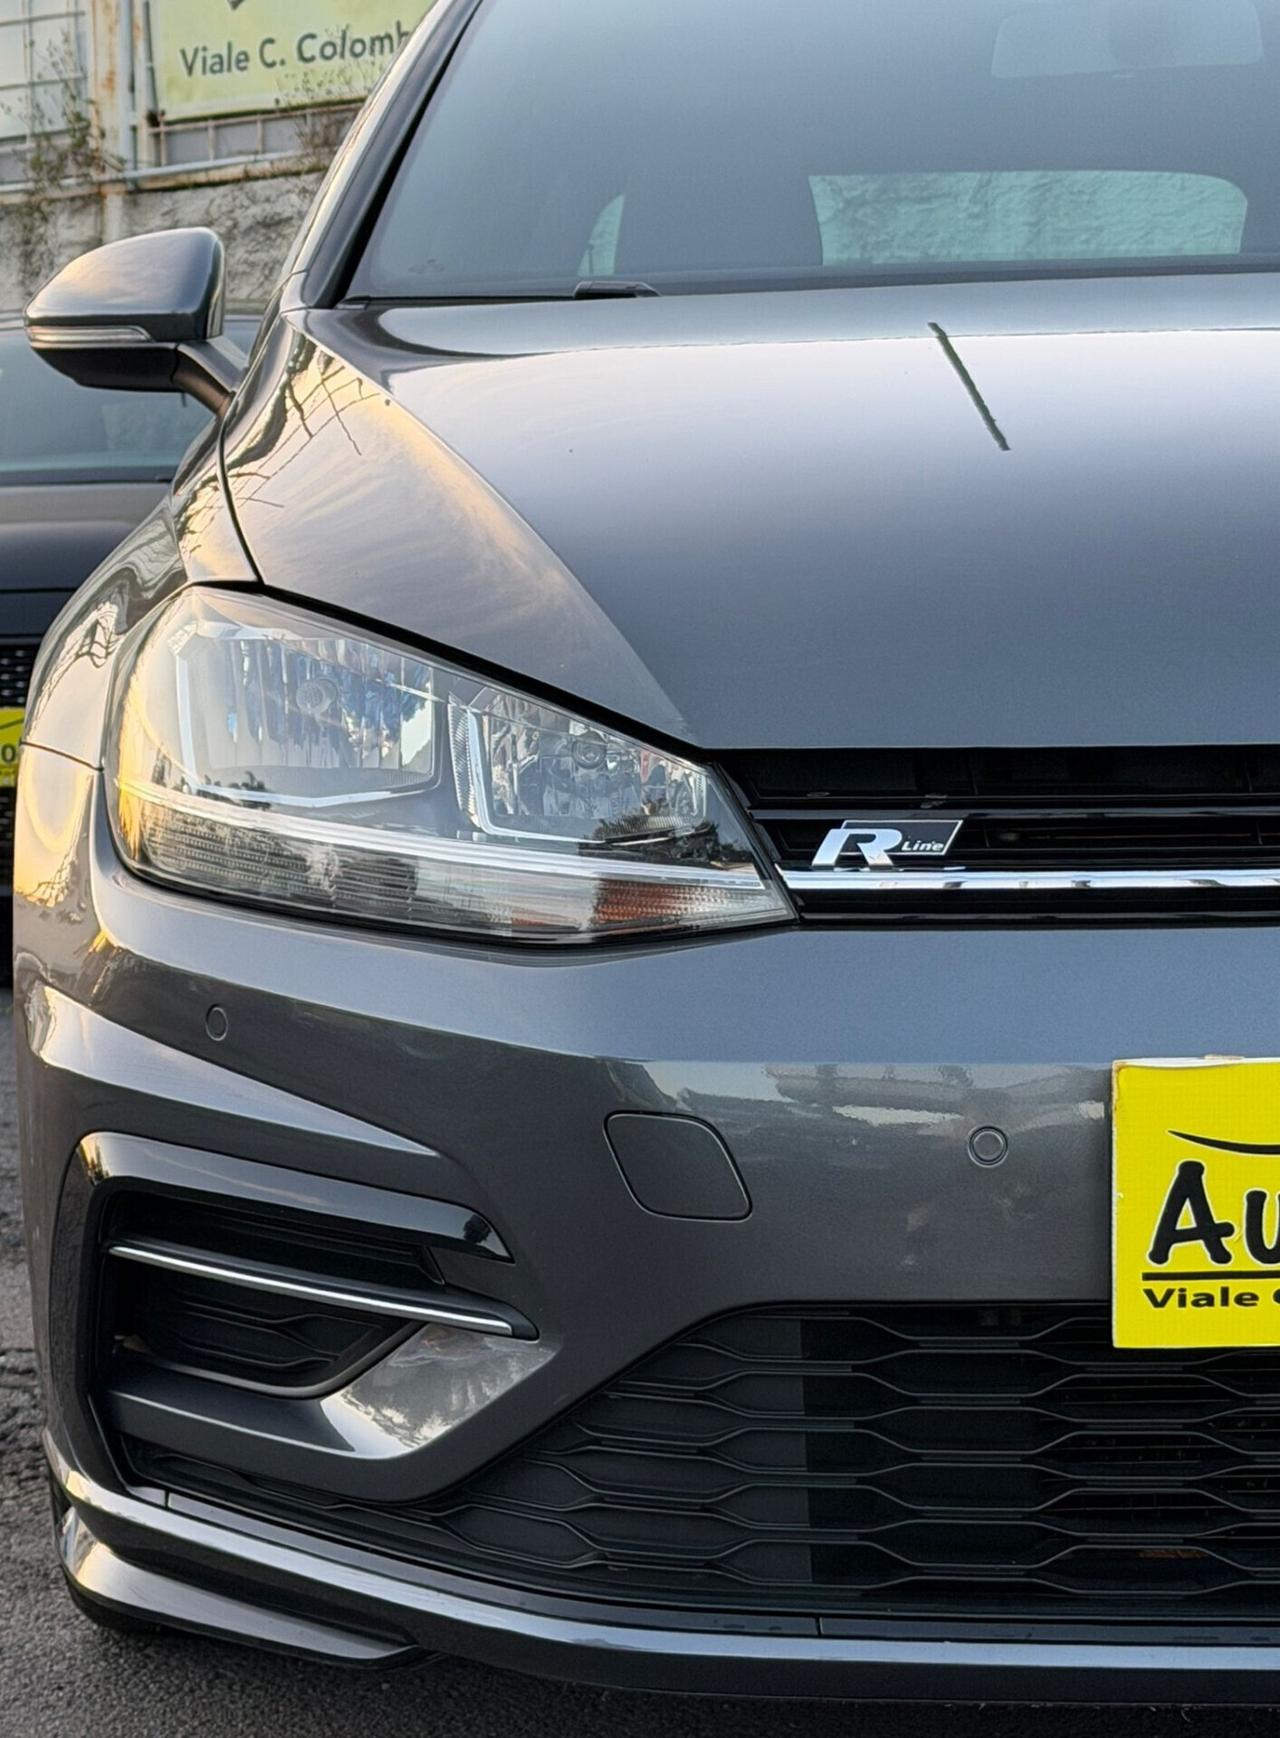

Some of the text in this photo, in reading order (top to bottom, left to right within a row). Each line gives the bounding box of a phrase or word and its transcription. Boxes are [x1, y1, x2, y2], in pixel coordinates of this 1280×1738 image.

[179, 41, 250, 78] Viale
[258, 37, 286, 69] C.
[811, 828, 944, 866] R Line
[1148, 1160, 1280, 1265] Au
[1143, 1286, 1260, 1309] Viale
